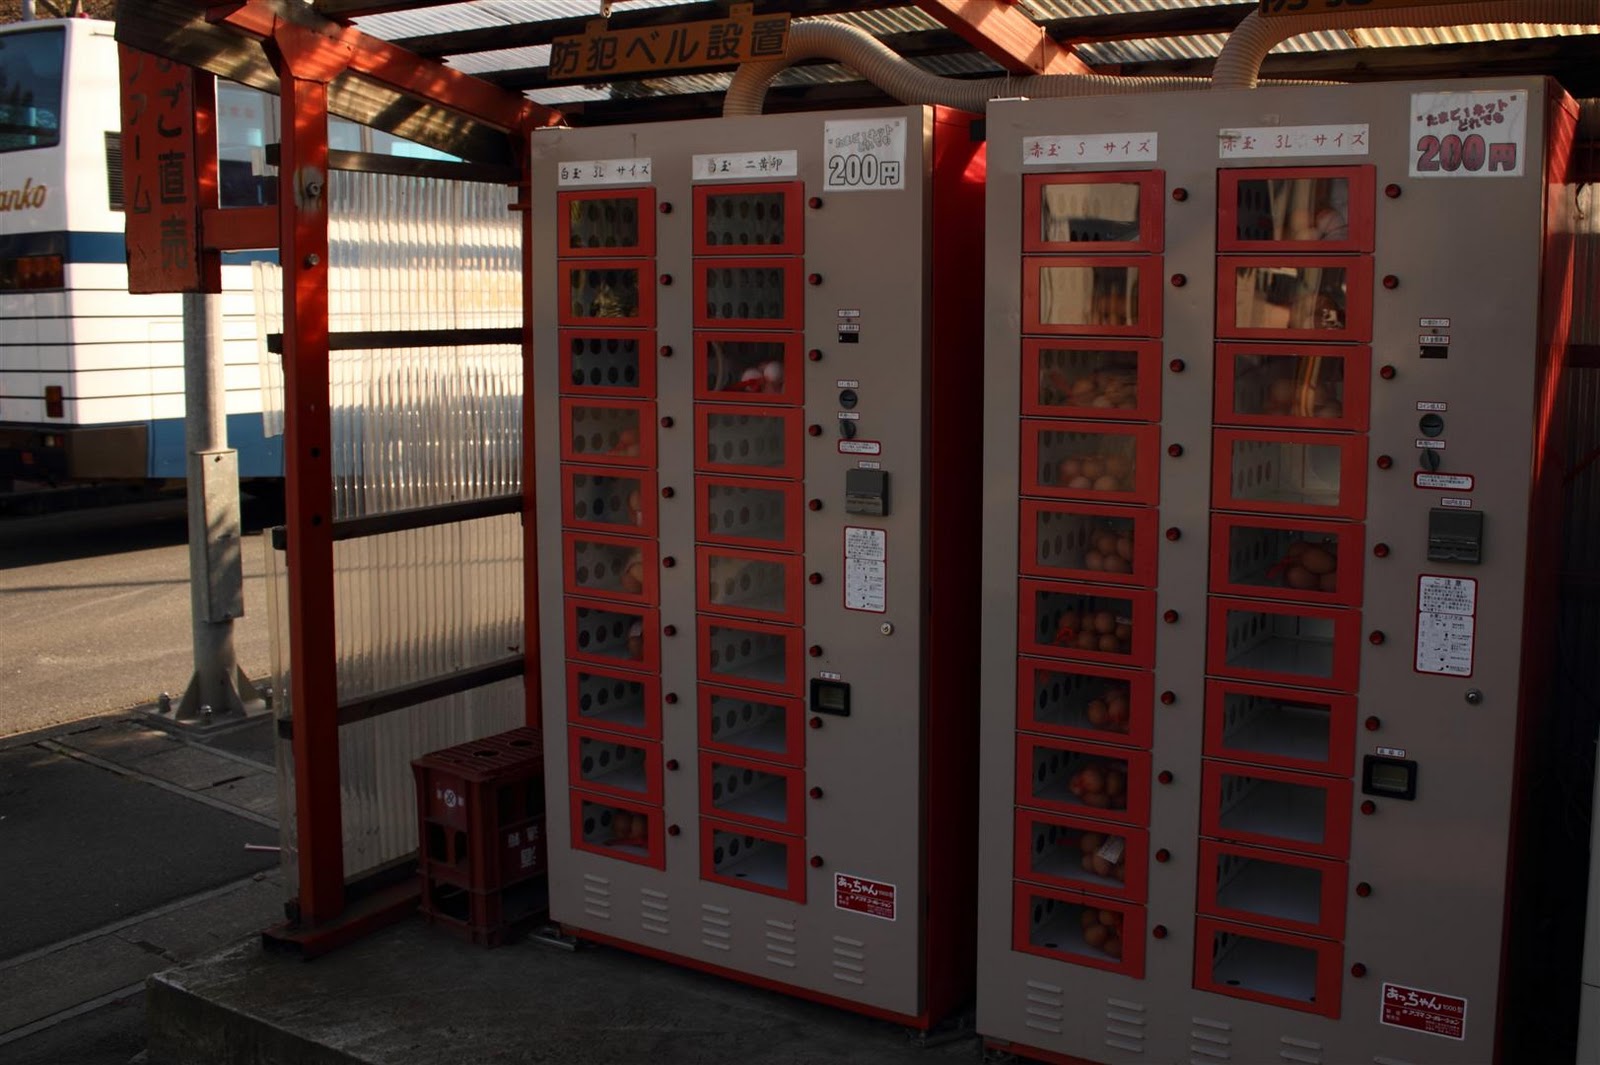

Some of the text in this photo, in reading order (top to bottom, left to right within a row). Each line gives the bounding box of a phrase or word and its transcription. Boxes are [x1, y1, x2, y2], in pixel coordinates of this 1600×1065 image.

[551, 18, 787, 74] 防犯ベル設置
[1030, 142, 1061, 158] 赤玉
[1103, 139, 1151, 155] サイズ
[1275, 134, 1292, 148] 3L
[1313, 130, 1366, 148] サイズ
[1416, 134, 1517, 171] 200円
[617, 163, 650, 176] サイズ
[829, 154, 900, 186] 200円
[1386, 986, 1442, 1011] あっちゃん
